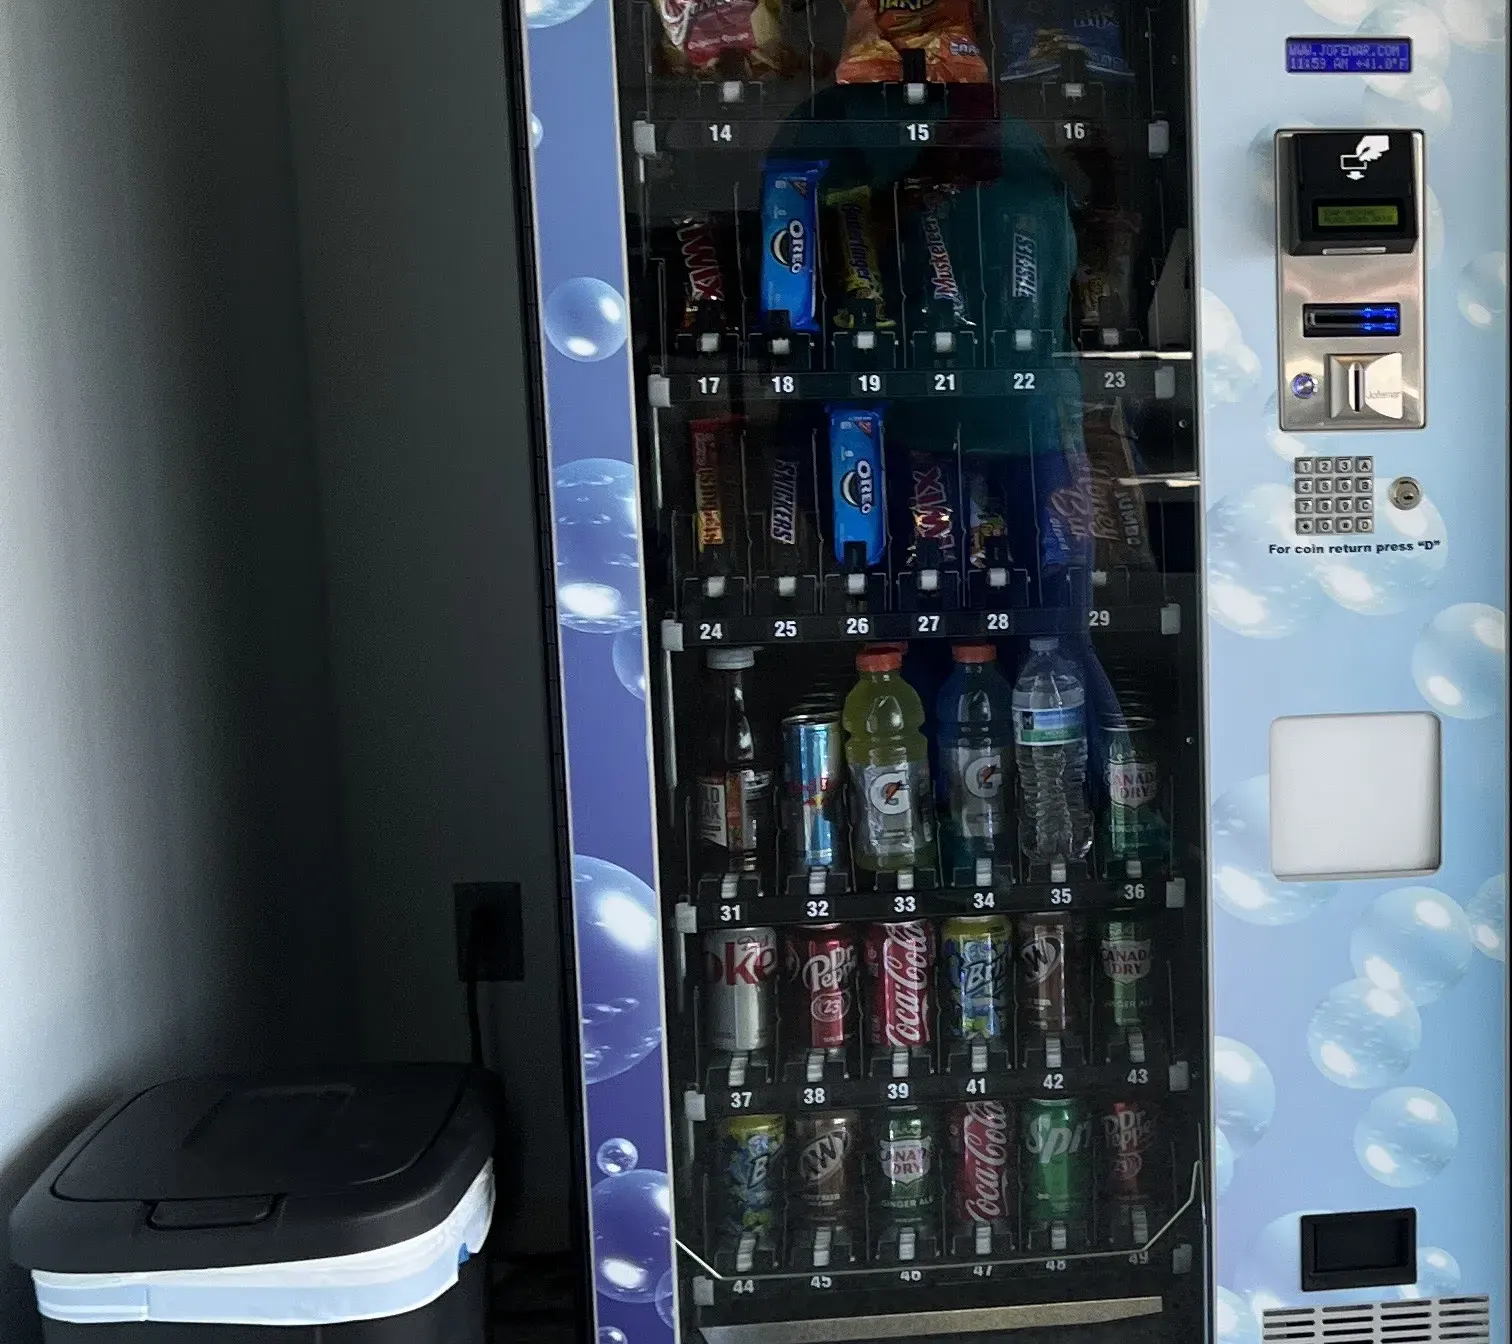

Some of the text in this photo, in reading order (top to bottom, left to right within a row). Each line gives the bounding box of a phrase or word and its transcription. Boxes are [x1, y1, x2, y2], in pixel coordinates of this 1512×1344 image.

[708, 124, 733, 142] 14
[906, 123, 931, 142] 15
[1063, 122, 1086, 140] 16
[788, 219, 805, 274] OREO
[697, 376, 721, 394] 17
[771, 375, 795, 394] 18
[858, 374, 882, 393] 19
[934, 373, 956, 391] 21
[1013, 372, 1036, 390] 22
[1104, 371, 1127, 389] 23
[1321, 462, 1328, 471] 2
[1341, 461, 1348, 471] 3
[1361, 461, 1369, 470] A
[856, 460, 873, 514] OREO
[1301, 481, 1369, 491] 4 5 6 B
[770, 459, 798, 545] SNICKERS
[1302, 501, 1369, 511] 7 8 9 C
[1361, 521, 1369, 530] D
[1268, 544, 1291, 555] For
[1294, 543, 1325, 554] coin
[1328, 543, 1372, 554] return
[1376, 543, 1414, 555] press
[846, 617, 870, 635] 26
[917, 615, 941, 633] 27
[986, 613, 1010, 631] 28
[1088, 610, 1111, 628] 29
[699, 623, 724, 641] 24
[773, 620, 798, 638] 25
[973, 892, 996, 909] 34
[1050, 887, 1073, 905] 35
[1123, 883, 1146, 900] 36
[806, 900, 830, 918] 32
[893, 895, 917, 913] 33
[720, 905, 742, 922] 31
[705, 941, 777, 986] oke
[801, 954, 858, 992] Pepp
[1042, 1073, 1065, 1090] 42
[1126, 1068, 1149, 1085] 43
[887, 1082, 910, 1100] 39
[965, 1078, 987, 1095] 41
[730, 1091, 753, 1109] 37
[803, 1087, 826, 1105] 38
[1025, 1113, 1093, 1165] Spr
[732, 1279, 756, 1295] 44
